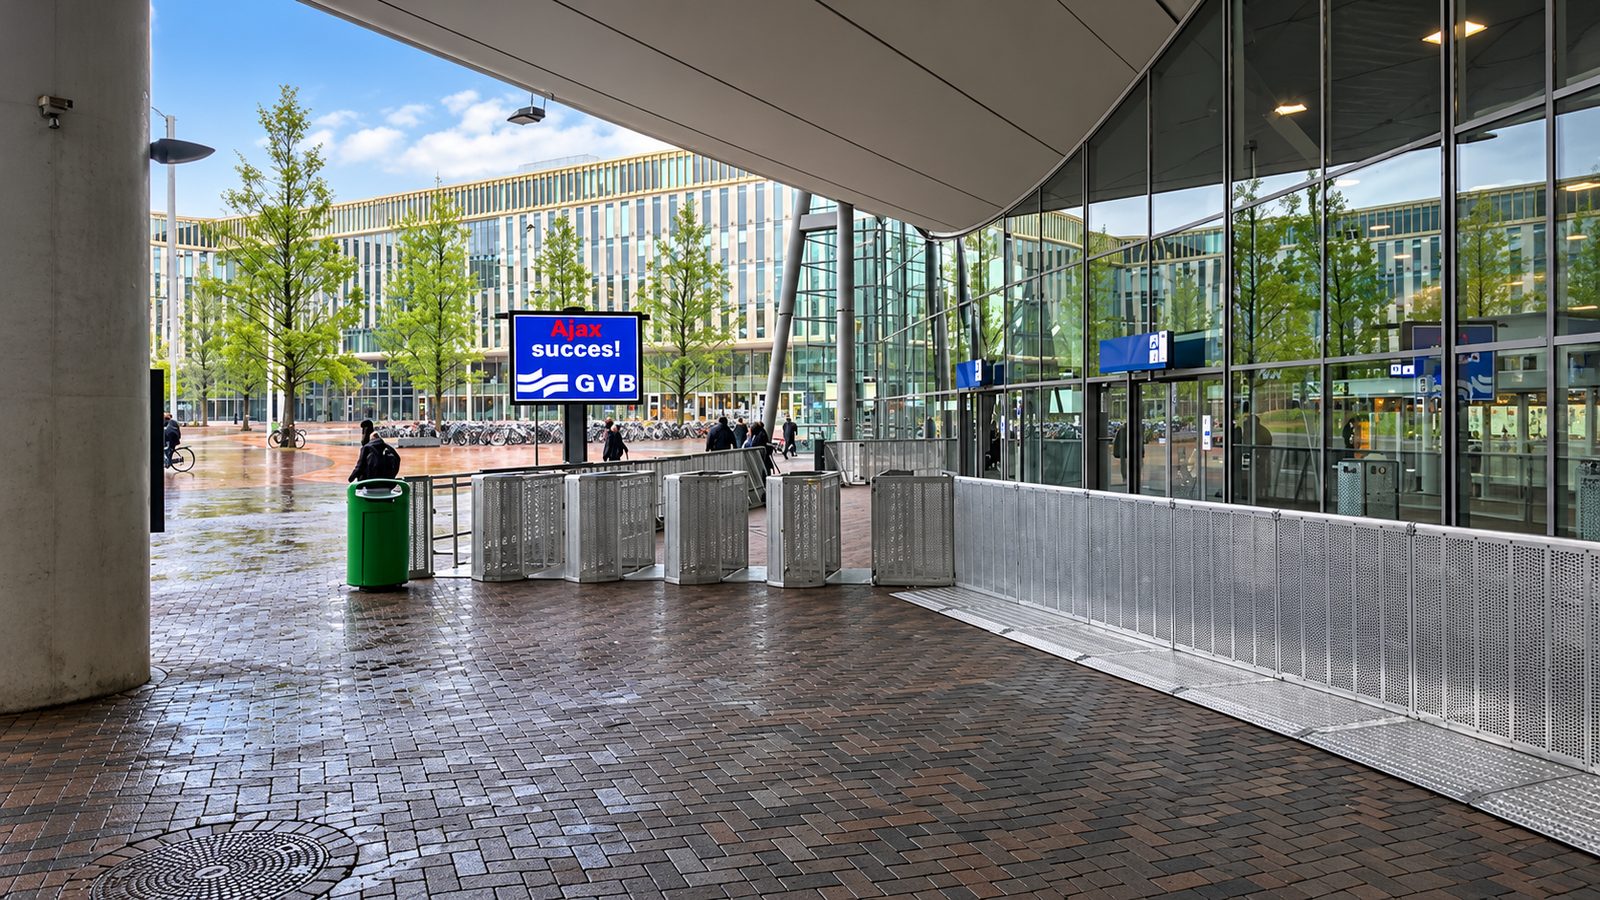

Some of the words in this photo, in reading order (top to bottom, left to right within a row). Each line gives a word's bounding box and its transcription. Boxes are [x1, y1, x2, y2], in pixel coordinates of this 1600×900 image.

[551, 319, 602, 341] Ajax
[531, 340, 620, 358] succes!
[575, 374, 636, 393] GVB
